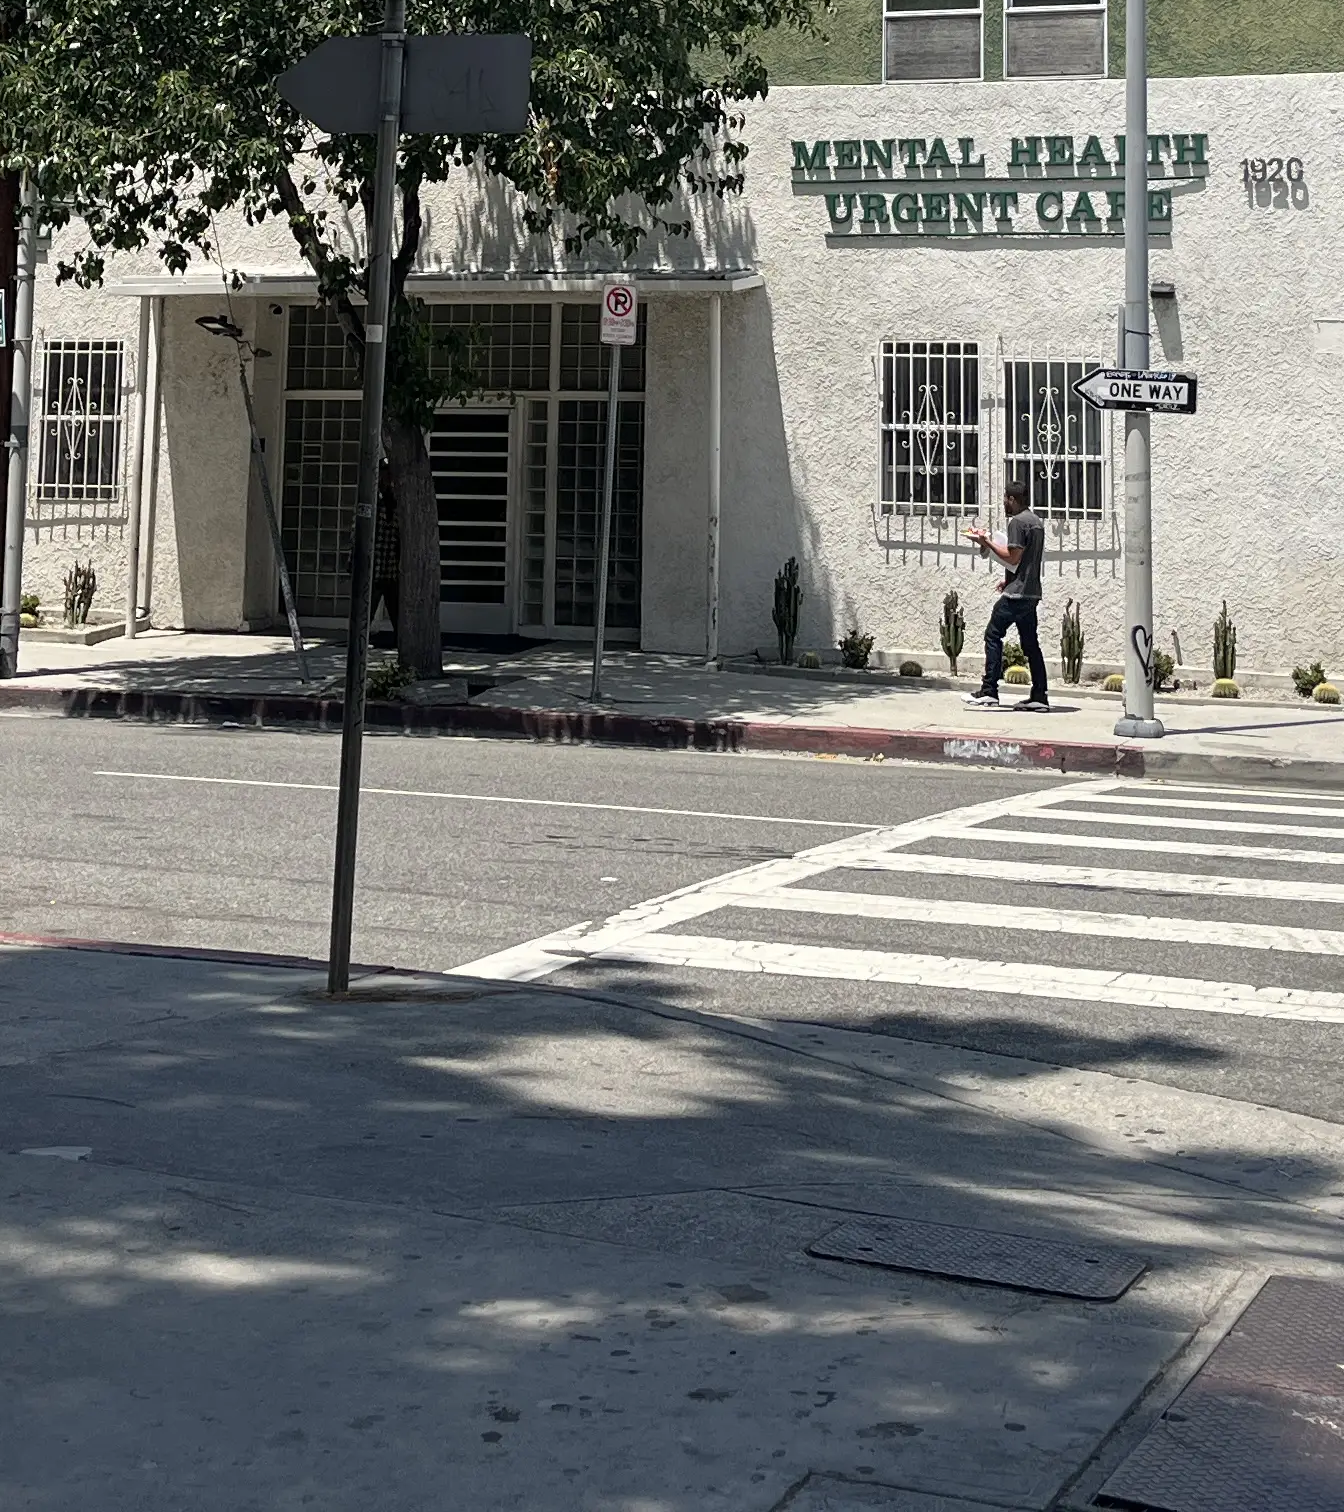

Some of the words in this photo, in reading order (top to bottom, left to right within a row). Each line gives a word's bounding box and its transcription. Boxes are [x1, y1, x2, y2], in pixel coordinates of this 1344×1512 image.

[791, 138, 985, 170] MENTAL
[1241, 156, 1304, 183] 1920
[825, 191, 1018, 224] URGENT
[1109, 382, 1142, 399] ONE
[1149, 384, 1183, 400] WAY
